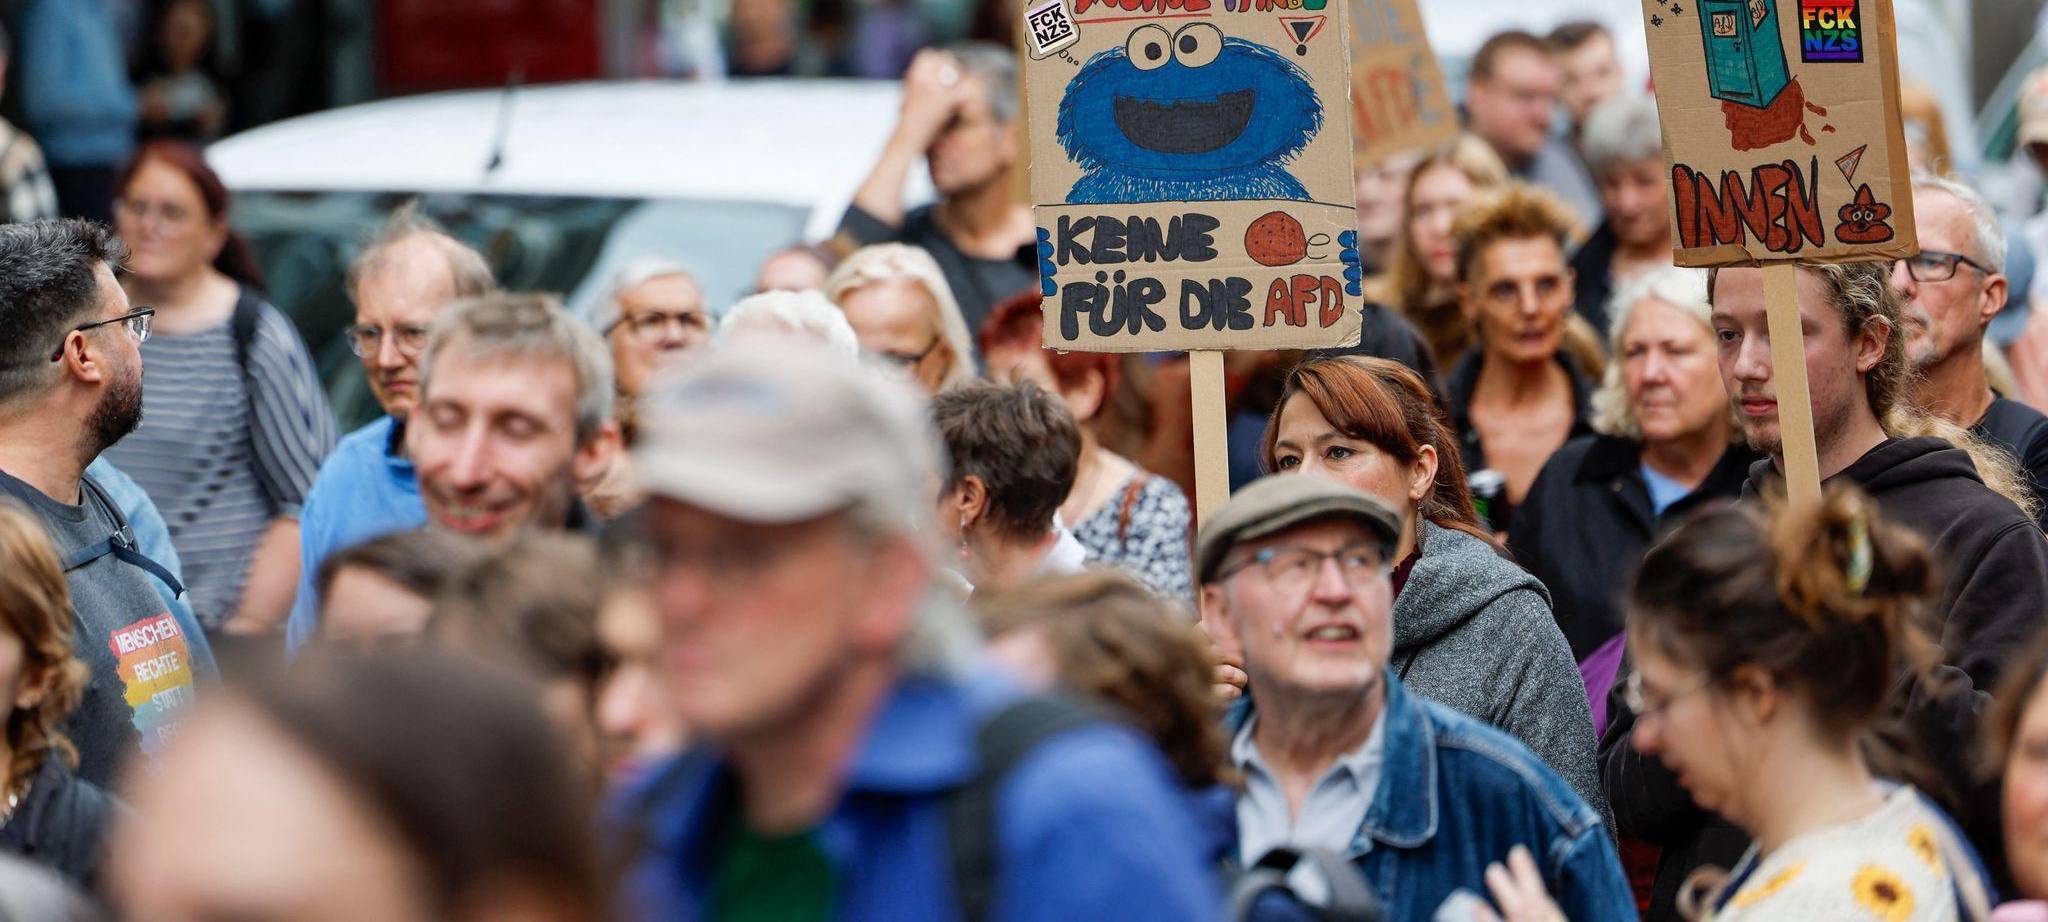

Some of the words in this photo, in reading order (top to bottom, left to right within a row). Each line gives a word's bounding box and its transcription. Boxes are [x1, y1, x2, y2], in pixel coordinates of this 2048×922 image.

[1030, 6, 1066, 32] FCK
[1035, 20, 1071, 45] NZS
[1803, 7, 1856, 29] FCK
[1804, 30, 1858, 51] NZS
[1672, 155, 1825, 253] INNEN
[1057, 213, 1220, 266] KEINE
[1060, 269, 1166, 341] FÜR
[1180, 276, 1255, 331] DIE
[1263, 274, 1345, 328] AFD
[115, 616, 179, 655] MENSCHEN
[132, 651, 181, 683] RECHTE
